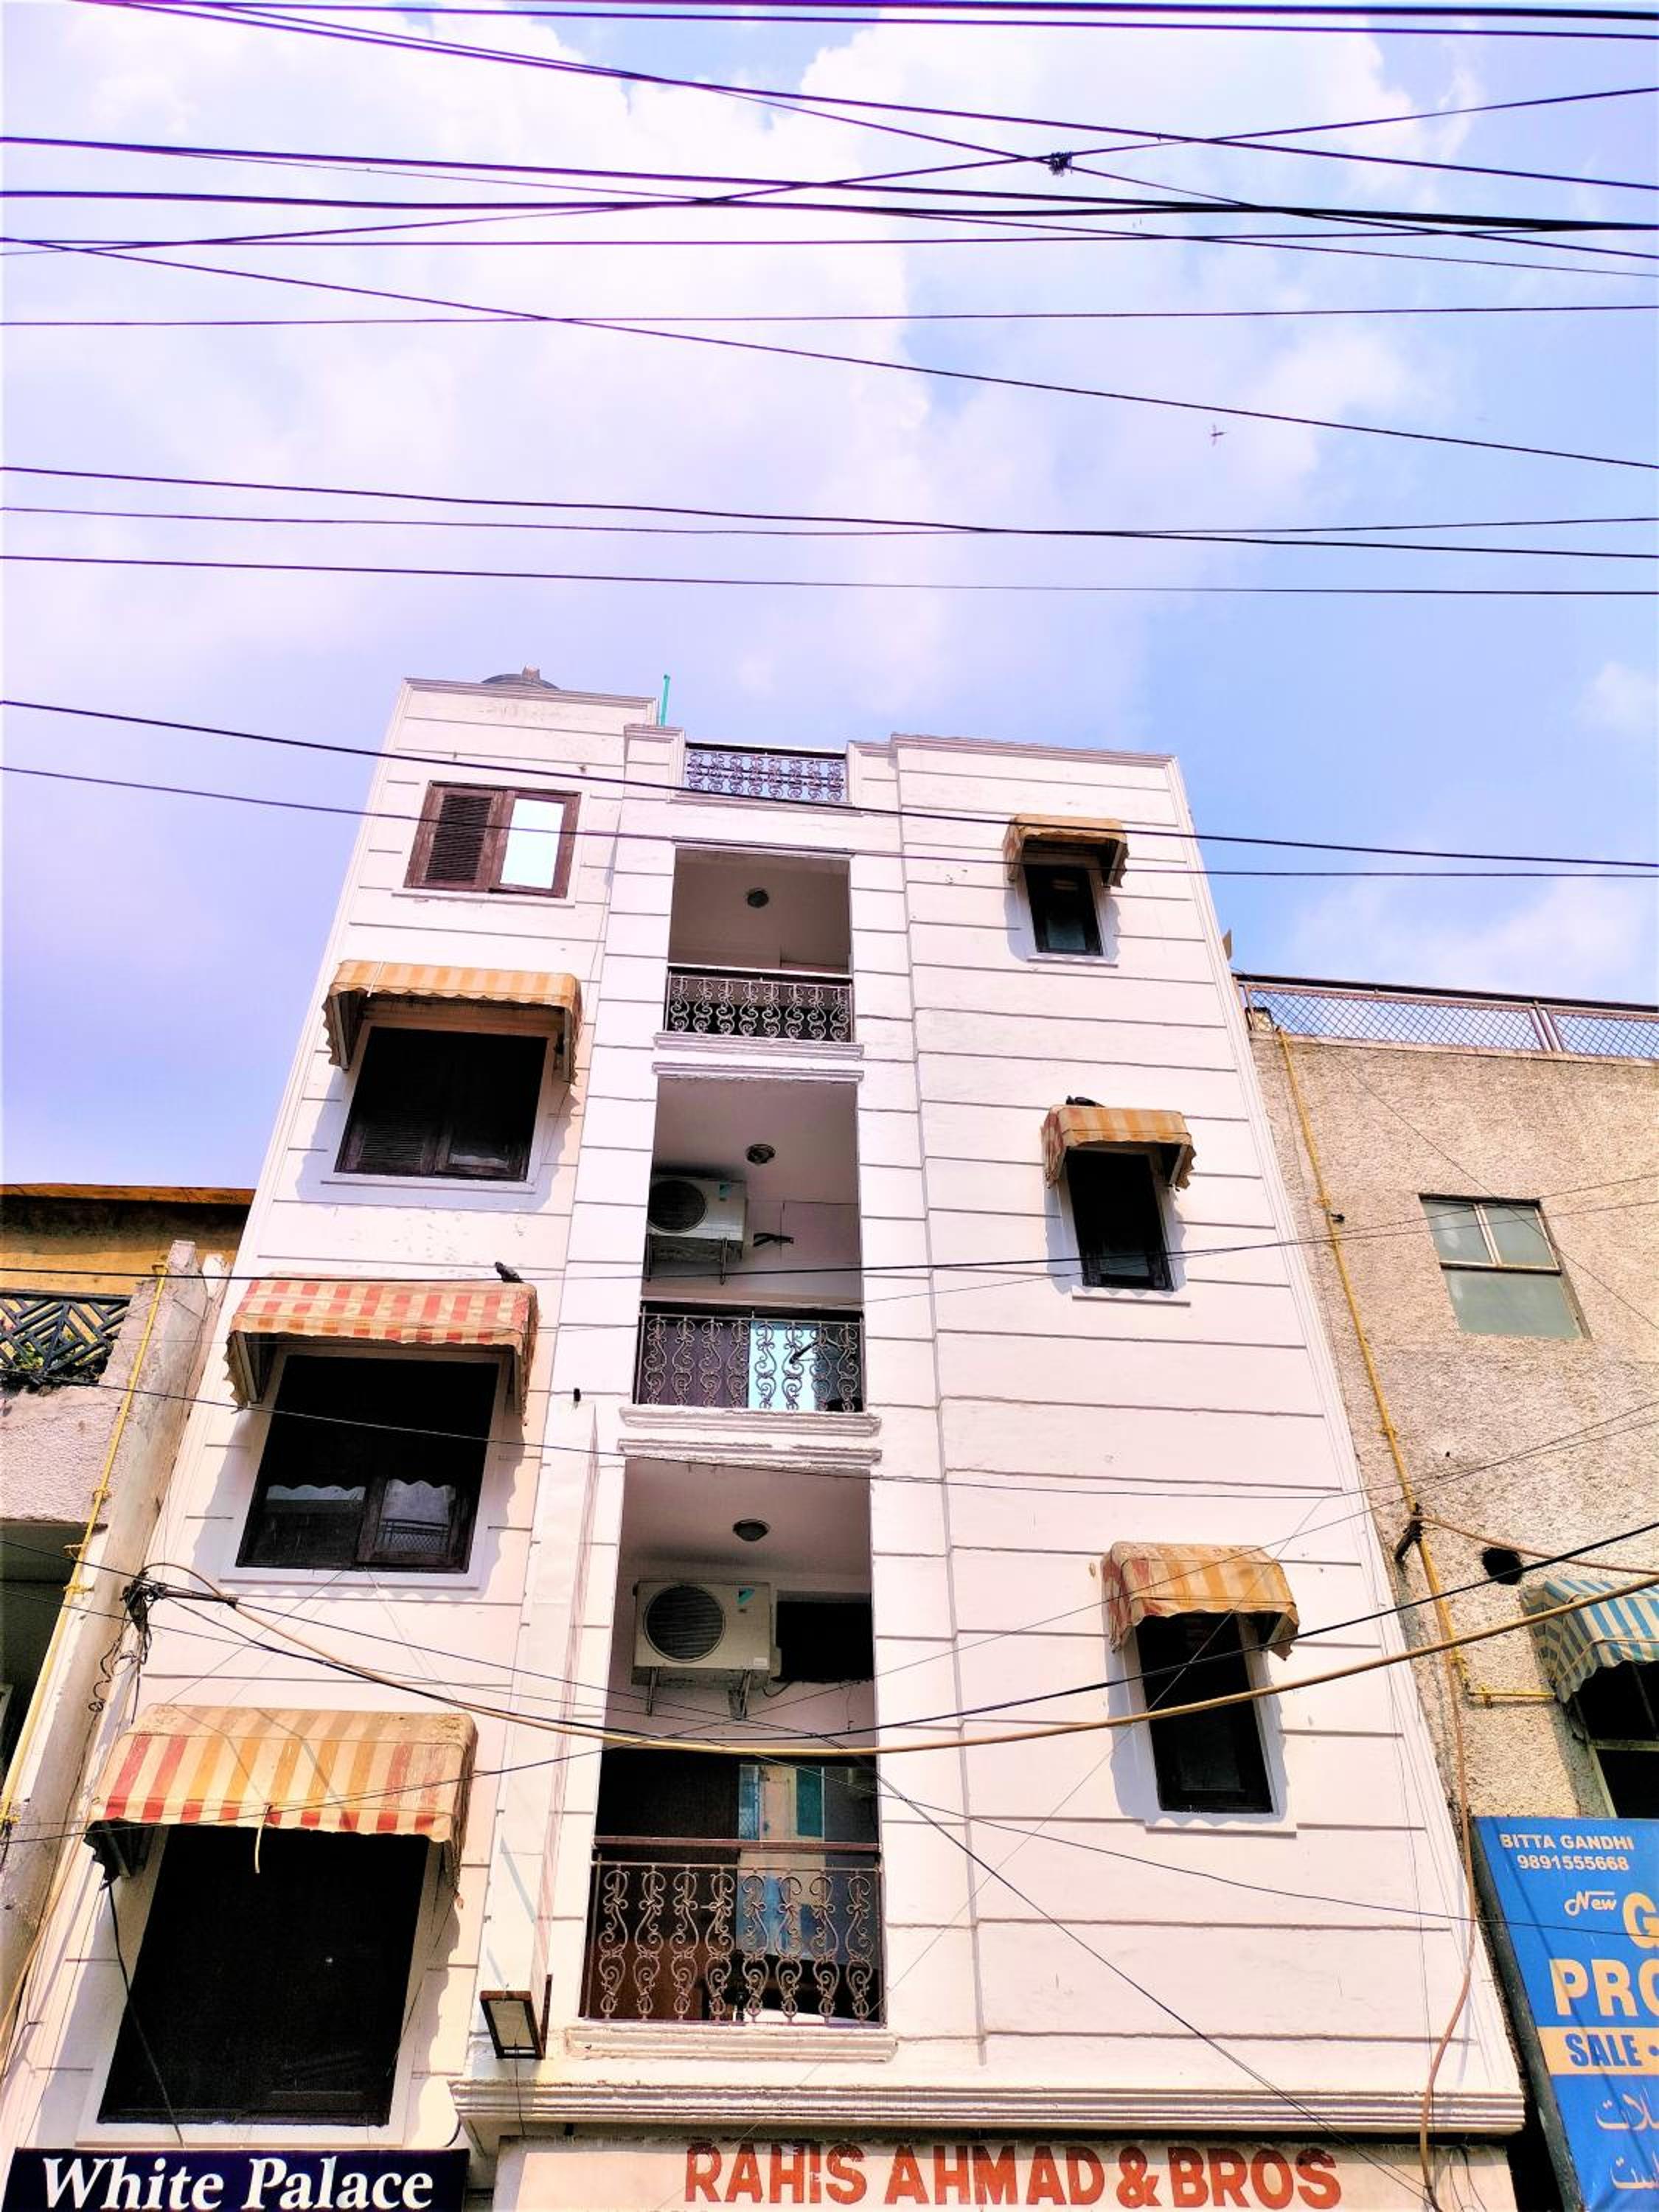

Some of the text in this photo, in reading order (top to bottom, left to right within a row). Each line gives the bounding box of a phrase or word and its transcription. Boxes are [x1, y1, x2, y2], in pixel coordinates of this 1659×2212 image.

[1499, 1834, 1635, 1850] BITTA GANDHI
[1517, 1854, 1630, 1871] 9891555668
[1564, 1891, 1617, 1916] New
[1565, 2033, 1643, 2067] SALE
[43, 2156, 434, 2211] White Palace
[685, 2143, 1342, 2210] RAHIS AHMAD & BROS
